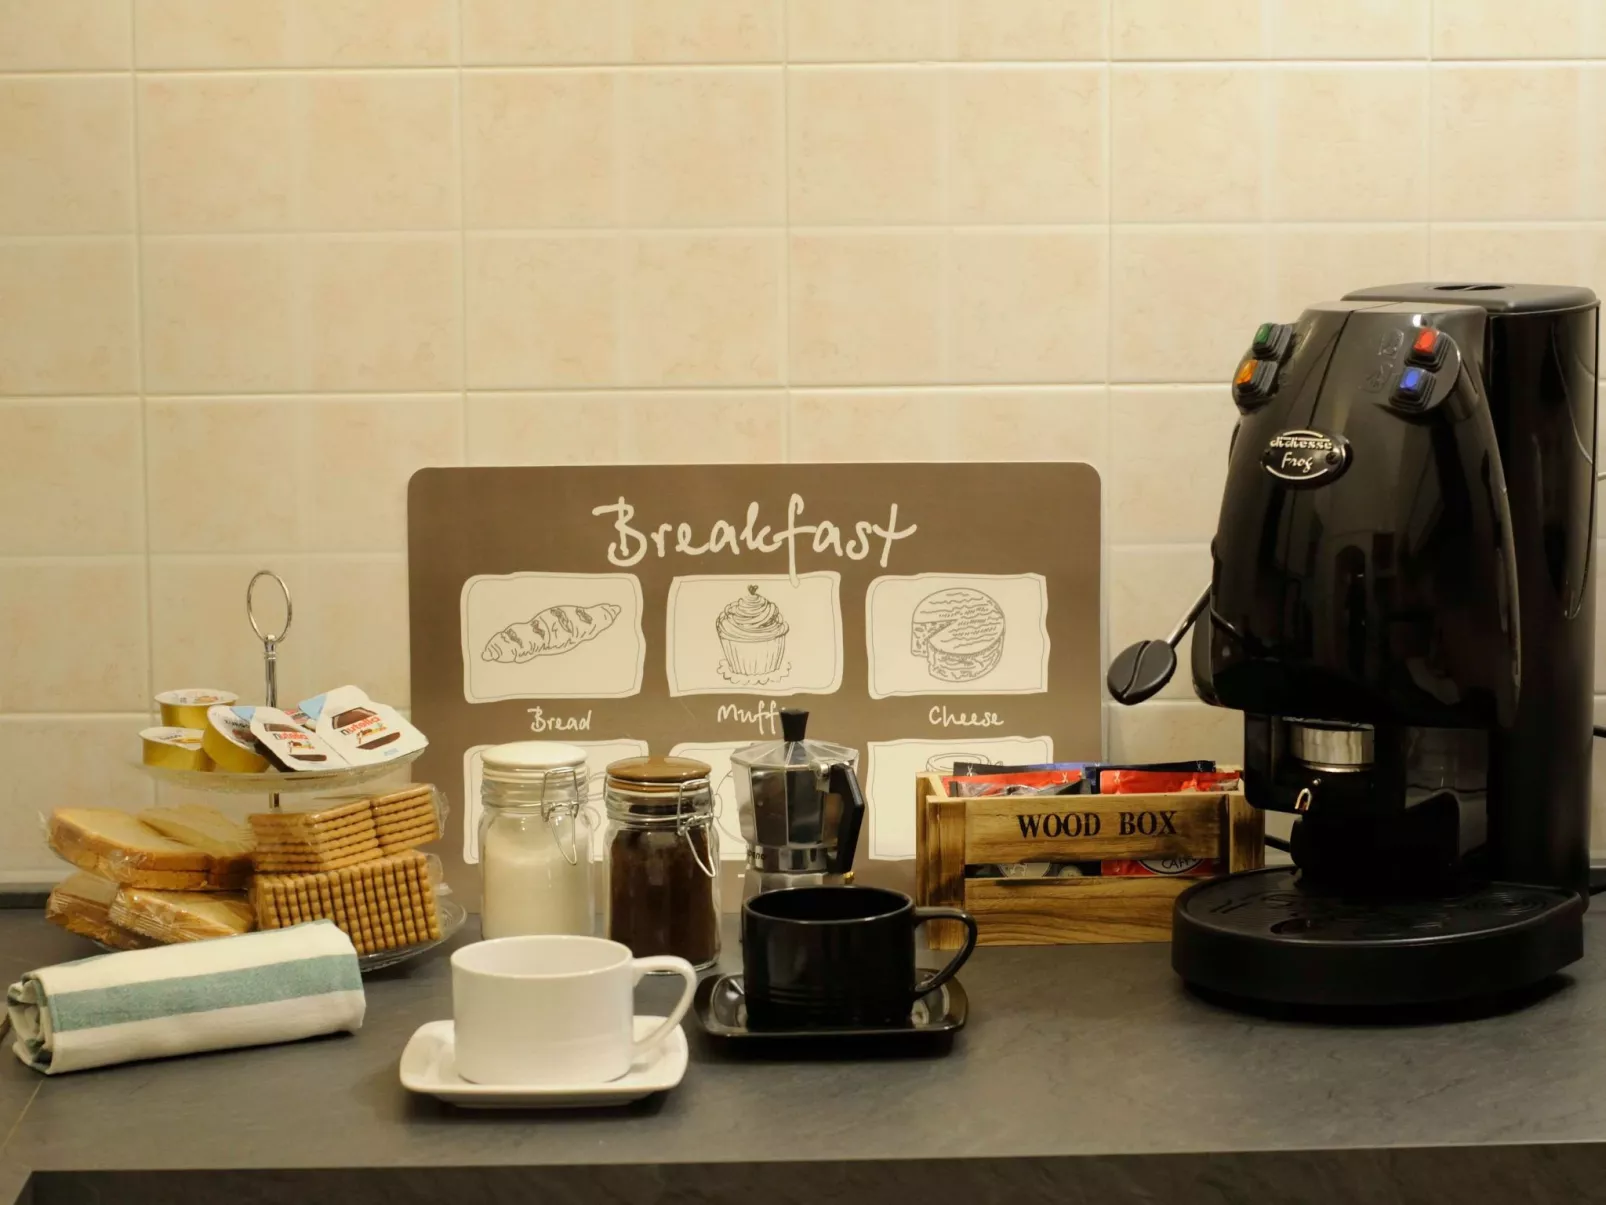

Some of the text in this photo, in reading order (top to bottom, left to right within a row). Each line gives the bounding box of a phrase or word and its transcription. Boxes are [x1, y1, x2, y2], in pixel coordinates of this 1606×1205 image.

[1270, 436, 1333, 449] didiesse
[1281, 452, 1313, 473] Frog
[592, 494, 917, 588] Breakfast
[340, 715, 381, 736] nutella
[527, 706, 592, 732] Bread
[717, 700, 785, 735] Muff
[928, 705, 1004, 727] Cheese
[273, 731, 309, 741] nutella
[1017, 811, 1178, 838] WOOD BOX
